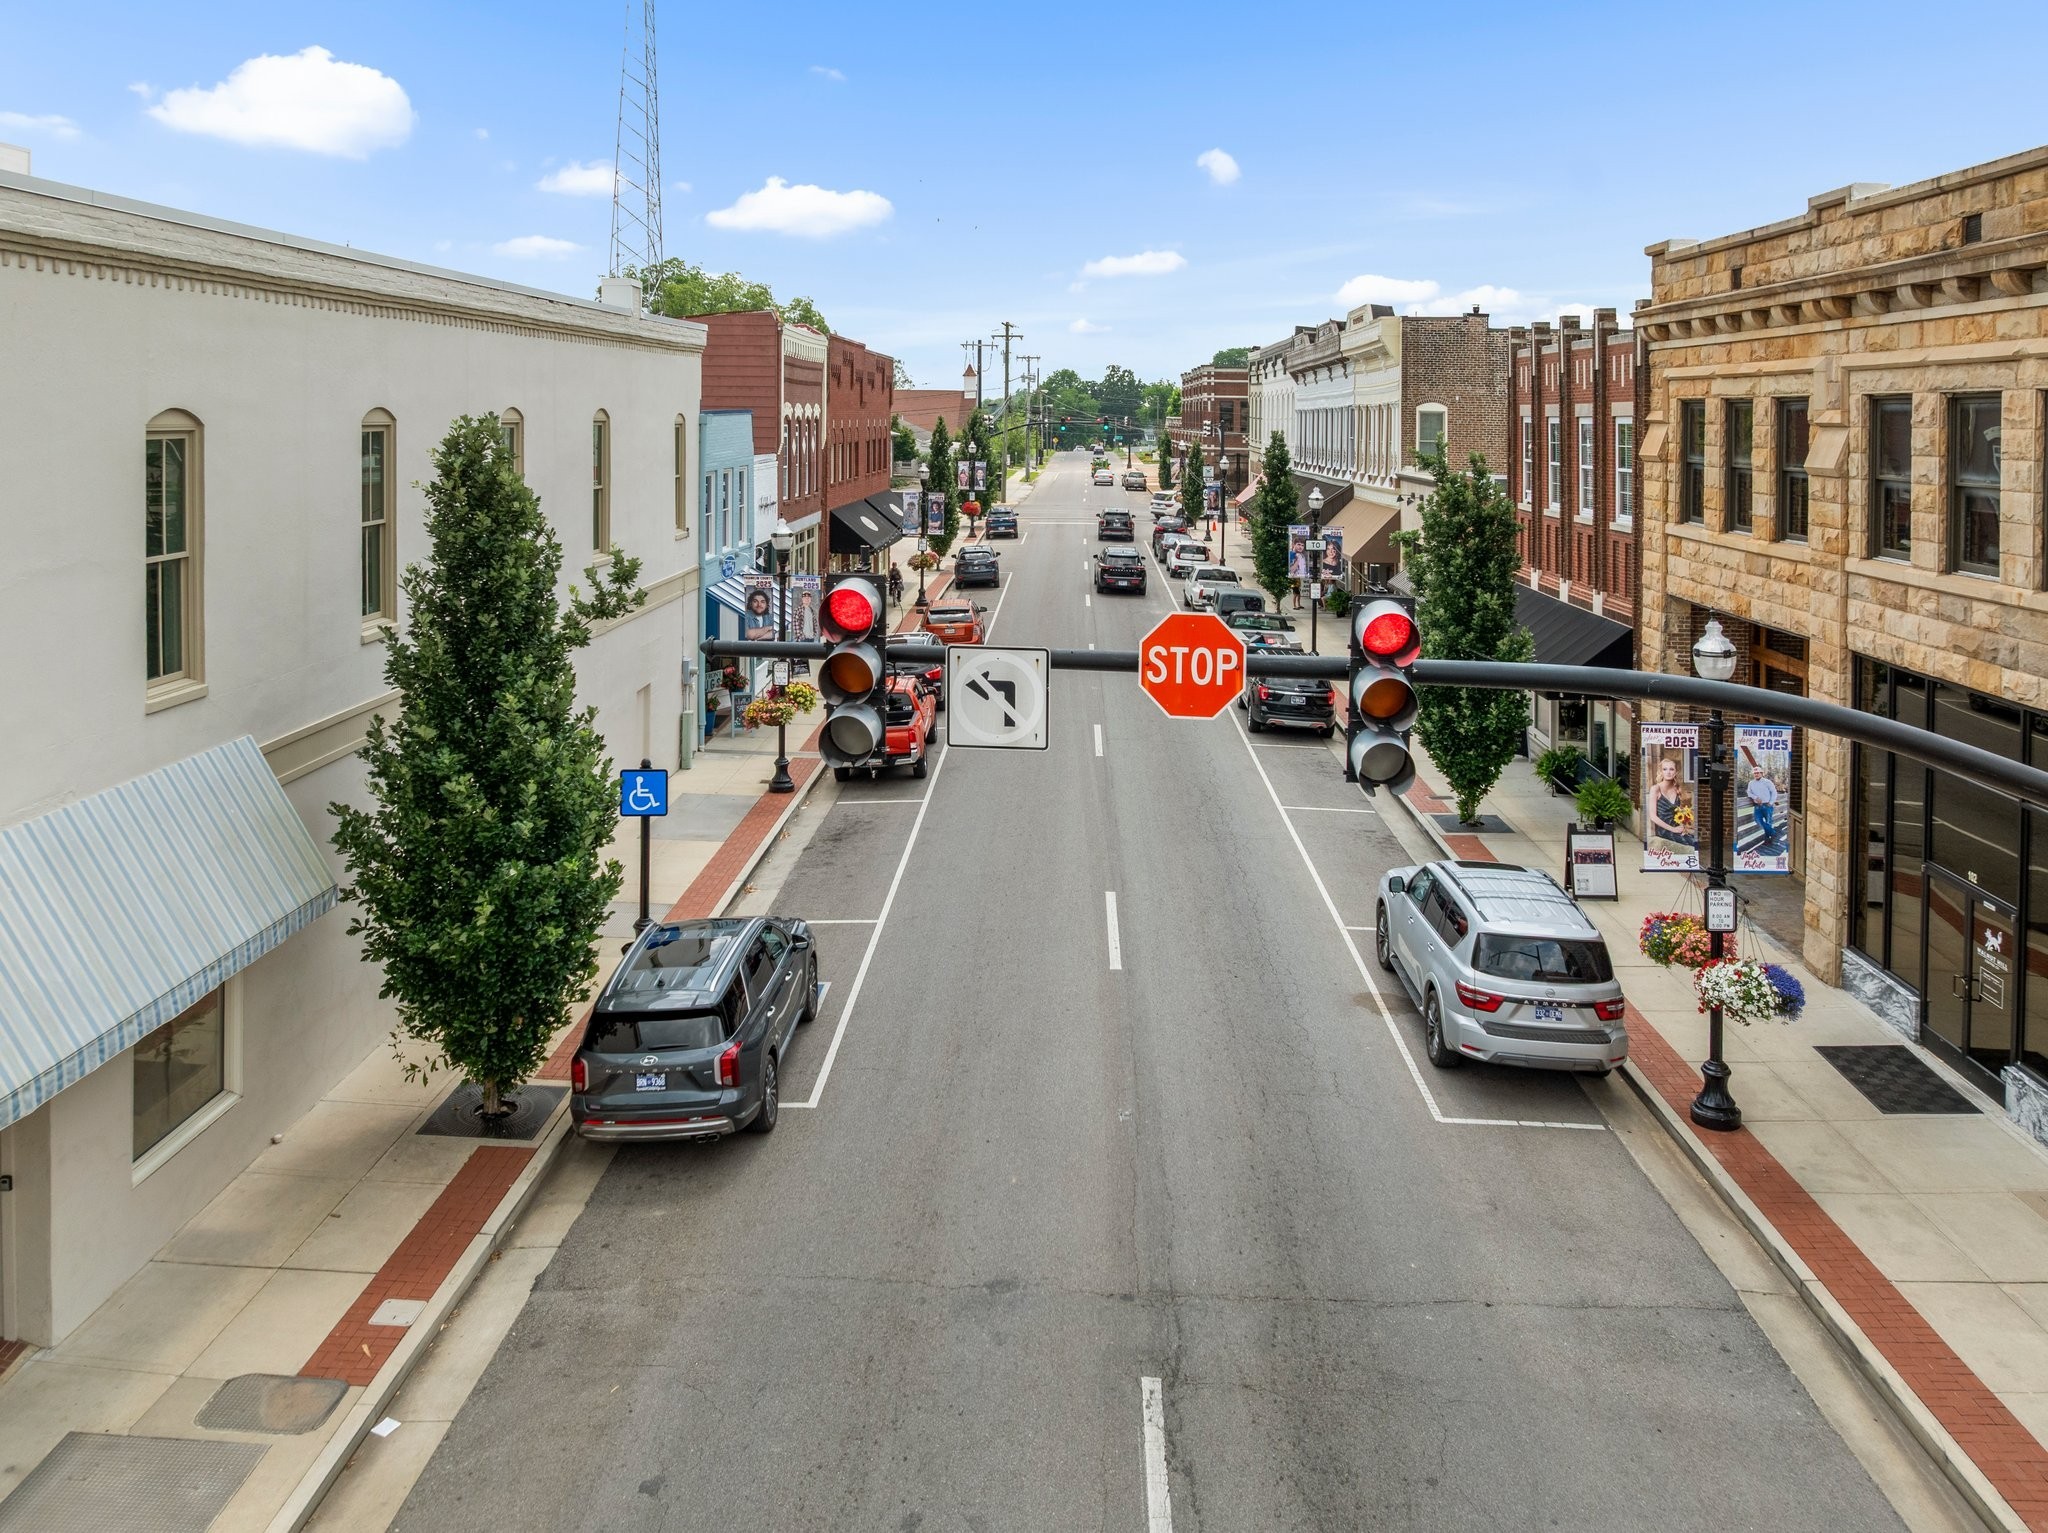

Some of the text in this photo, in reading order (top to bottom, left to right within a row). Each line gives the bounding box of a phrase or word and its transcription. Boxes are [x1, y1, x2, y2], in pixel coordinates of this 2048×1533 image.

[1146, 645, 1238, 686] STOP
[1673, 727, 1698, 735] COUNTY
[1743, 729, 1783, 738] HUNTLAND
[1665, 736, 1695, 748] 2025
[1757, 739, 1789, 750] 2025
[1524, 1000, 1577, 1008] ARMADA
